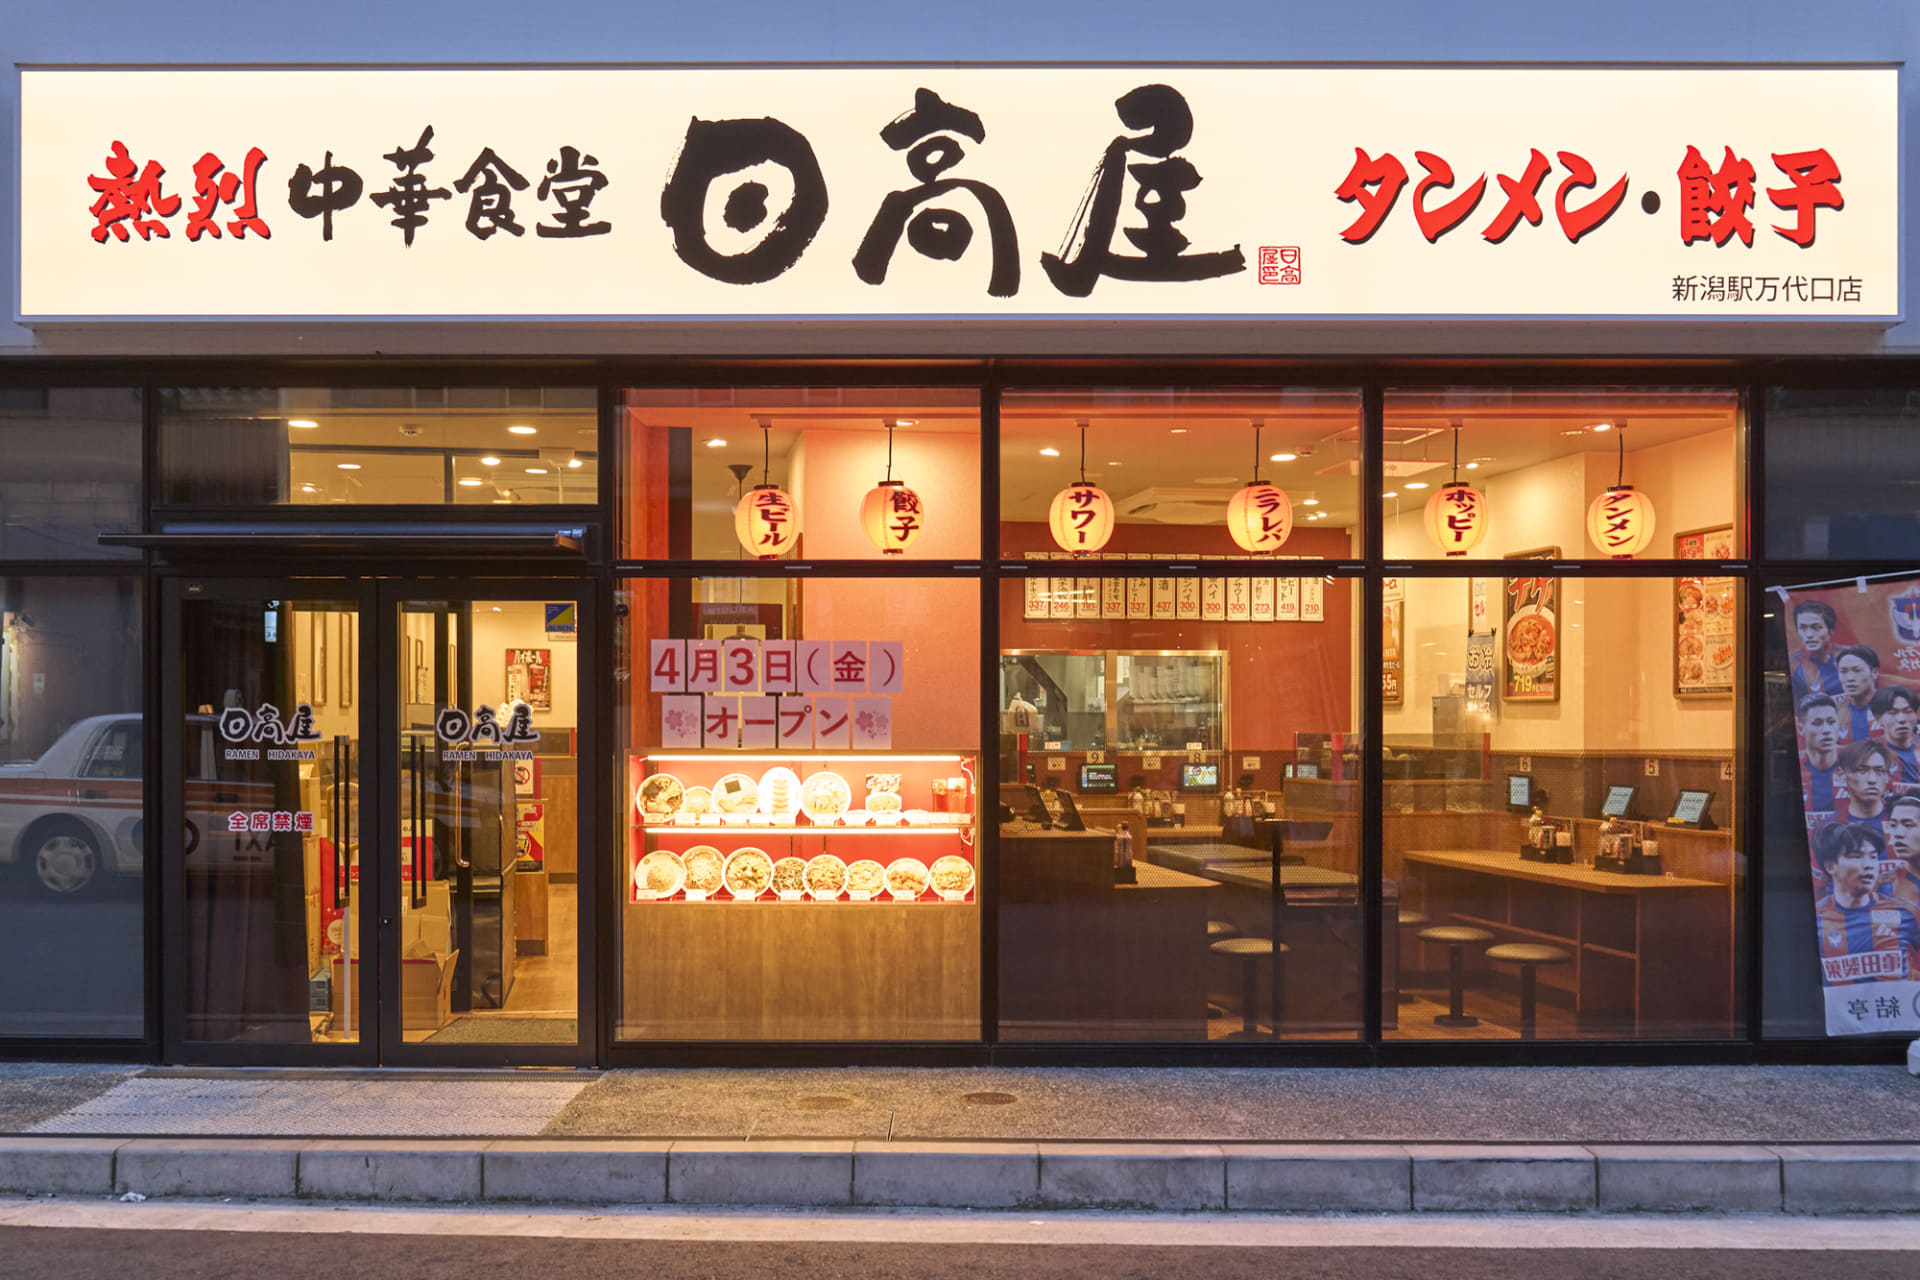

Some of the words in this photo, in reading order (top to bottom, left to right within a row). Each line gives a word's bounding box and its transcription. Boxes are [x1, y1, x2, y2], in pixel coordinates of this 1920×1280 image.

[87, 125, 612, 248] 熱烈中華食堂
[661, 84, 1246, 298] 日高屋
[1334, 144, 1844, 249] タンメン・餃子
[1671, 275, 1864, 303] 新潟駅万代口店
[756, 491, 790, 547] 生ビール
[890, 489, 920, 541] 餃子
[1068, 489, 1100, 544] サワー
[1254, 488, 1283, 544] ニラレバ
[1446, 489, 1476, 543] ホッピー
[1602, 493, 1635, 548] タンメン
[1467, 684, 1492, 698] セルフ
[220, 703, 322, 744] 日高屋
[436, 703, 541, 743] 日高屋
[706, 704, 849, 738] オープン
[225, 750, 260, 760] RAMEN
[268, 750, 316, 760] HIDAKAYA
[442, 750, 477, 760] RAMEN
[485, 750, 533, 760] HIDAKAYA
[228, 811, 314, 831] 全席禁煙
